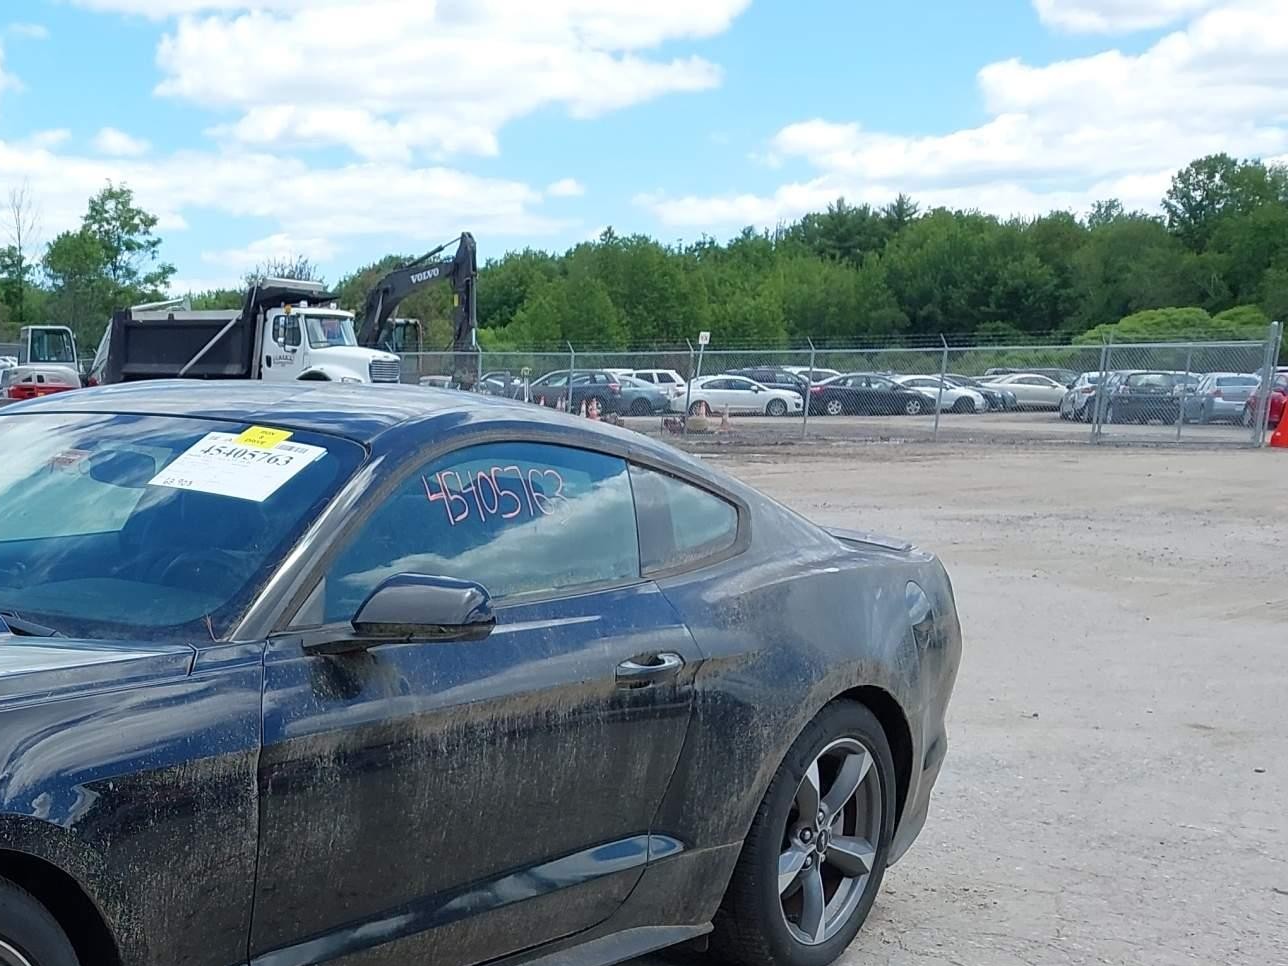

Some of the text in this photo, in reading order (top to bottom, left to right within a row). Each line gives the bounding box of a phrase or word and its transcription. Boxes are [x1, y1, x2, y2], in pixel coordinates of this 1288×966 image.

[411, 268, 440, 284] VOLVO
[200, 444, 295, 467] 45405763
[421, 465, 569, 526] 45405763
